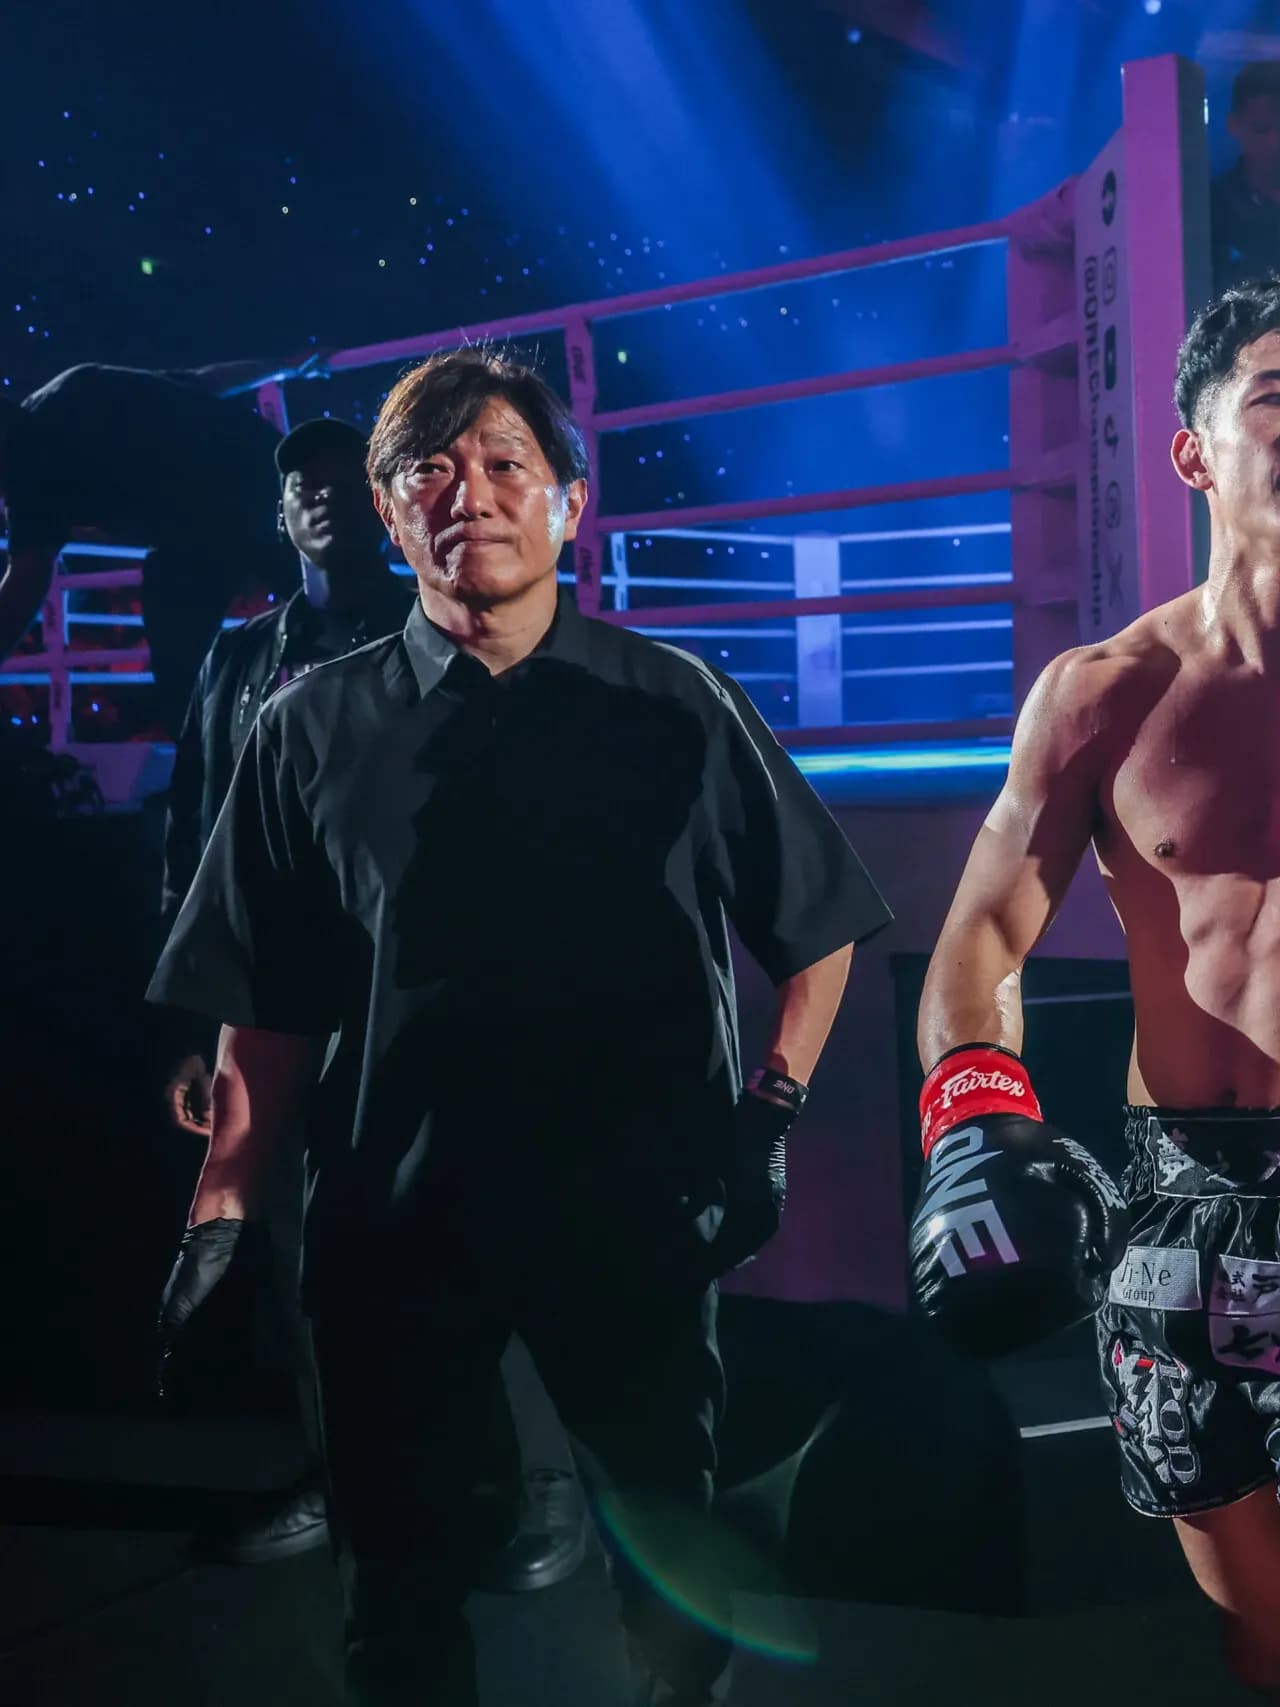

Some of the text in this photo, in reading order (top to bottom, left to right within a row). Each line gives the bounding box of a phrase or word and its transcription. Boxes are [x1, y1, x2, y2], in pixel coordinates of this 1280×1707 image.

[772, 1079, 796, 1095] ONE
[940, 1065, 1026, 1110] Fairtex
[912, 1125, 1021, 1279] ONE
